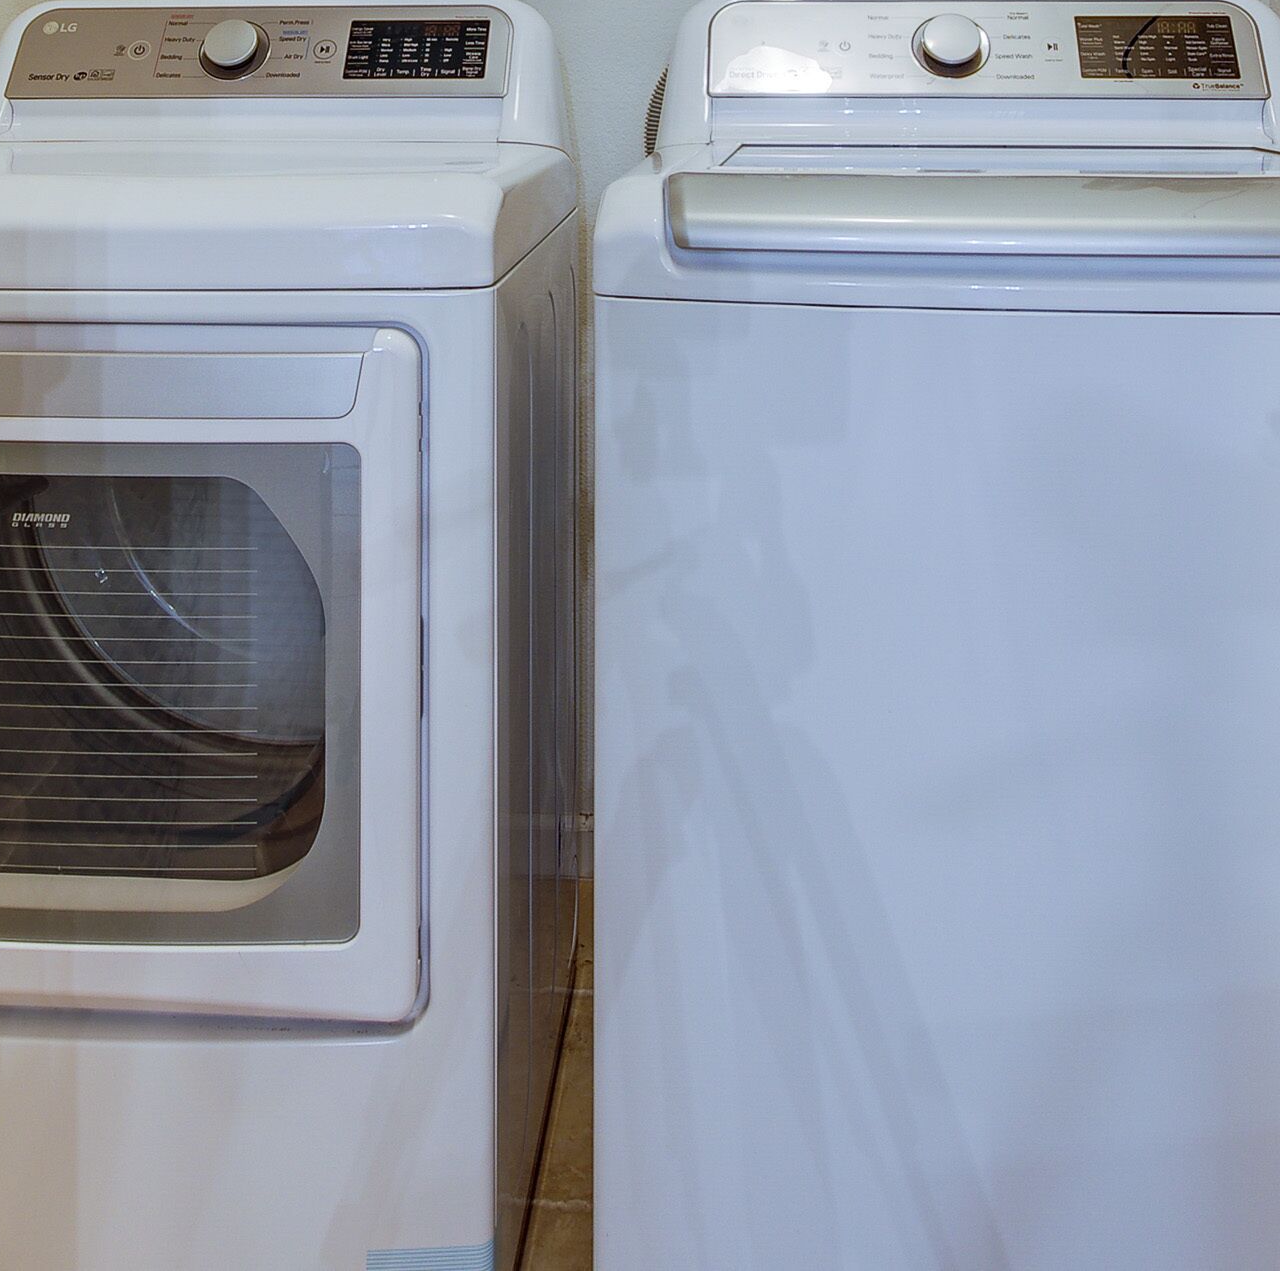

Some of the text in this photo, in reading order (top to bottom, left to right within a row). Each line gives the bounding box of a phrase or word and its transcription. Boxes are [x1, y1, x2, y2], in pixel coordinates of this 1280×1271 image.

[28, 73, 70, 83] Sensor Dry
[12, 512, 71, 523] DIAMOND
